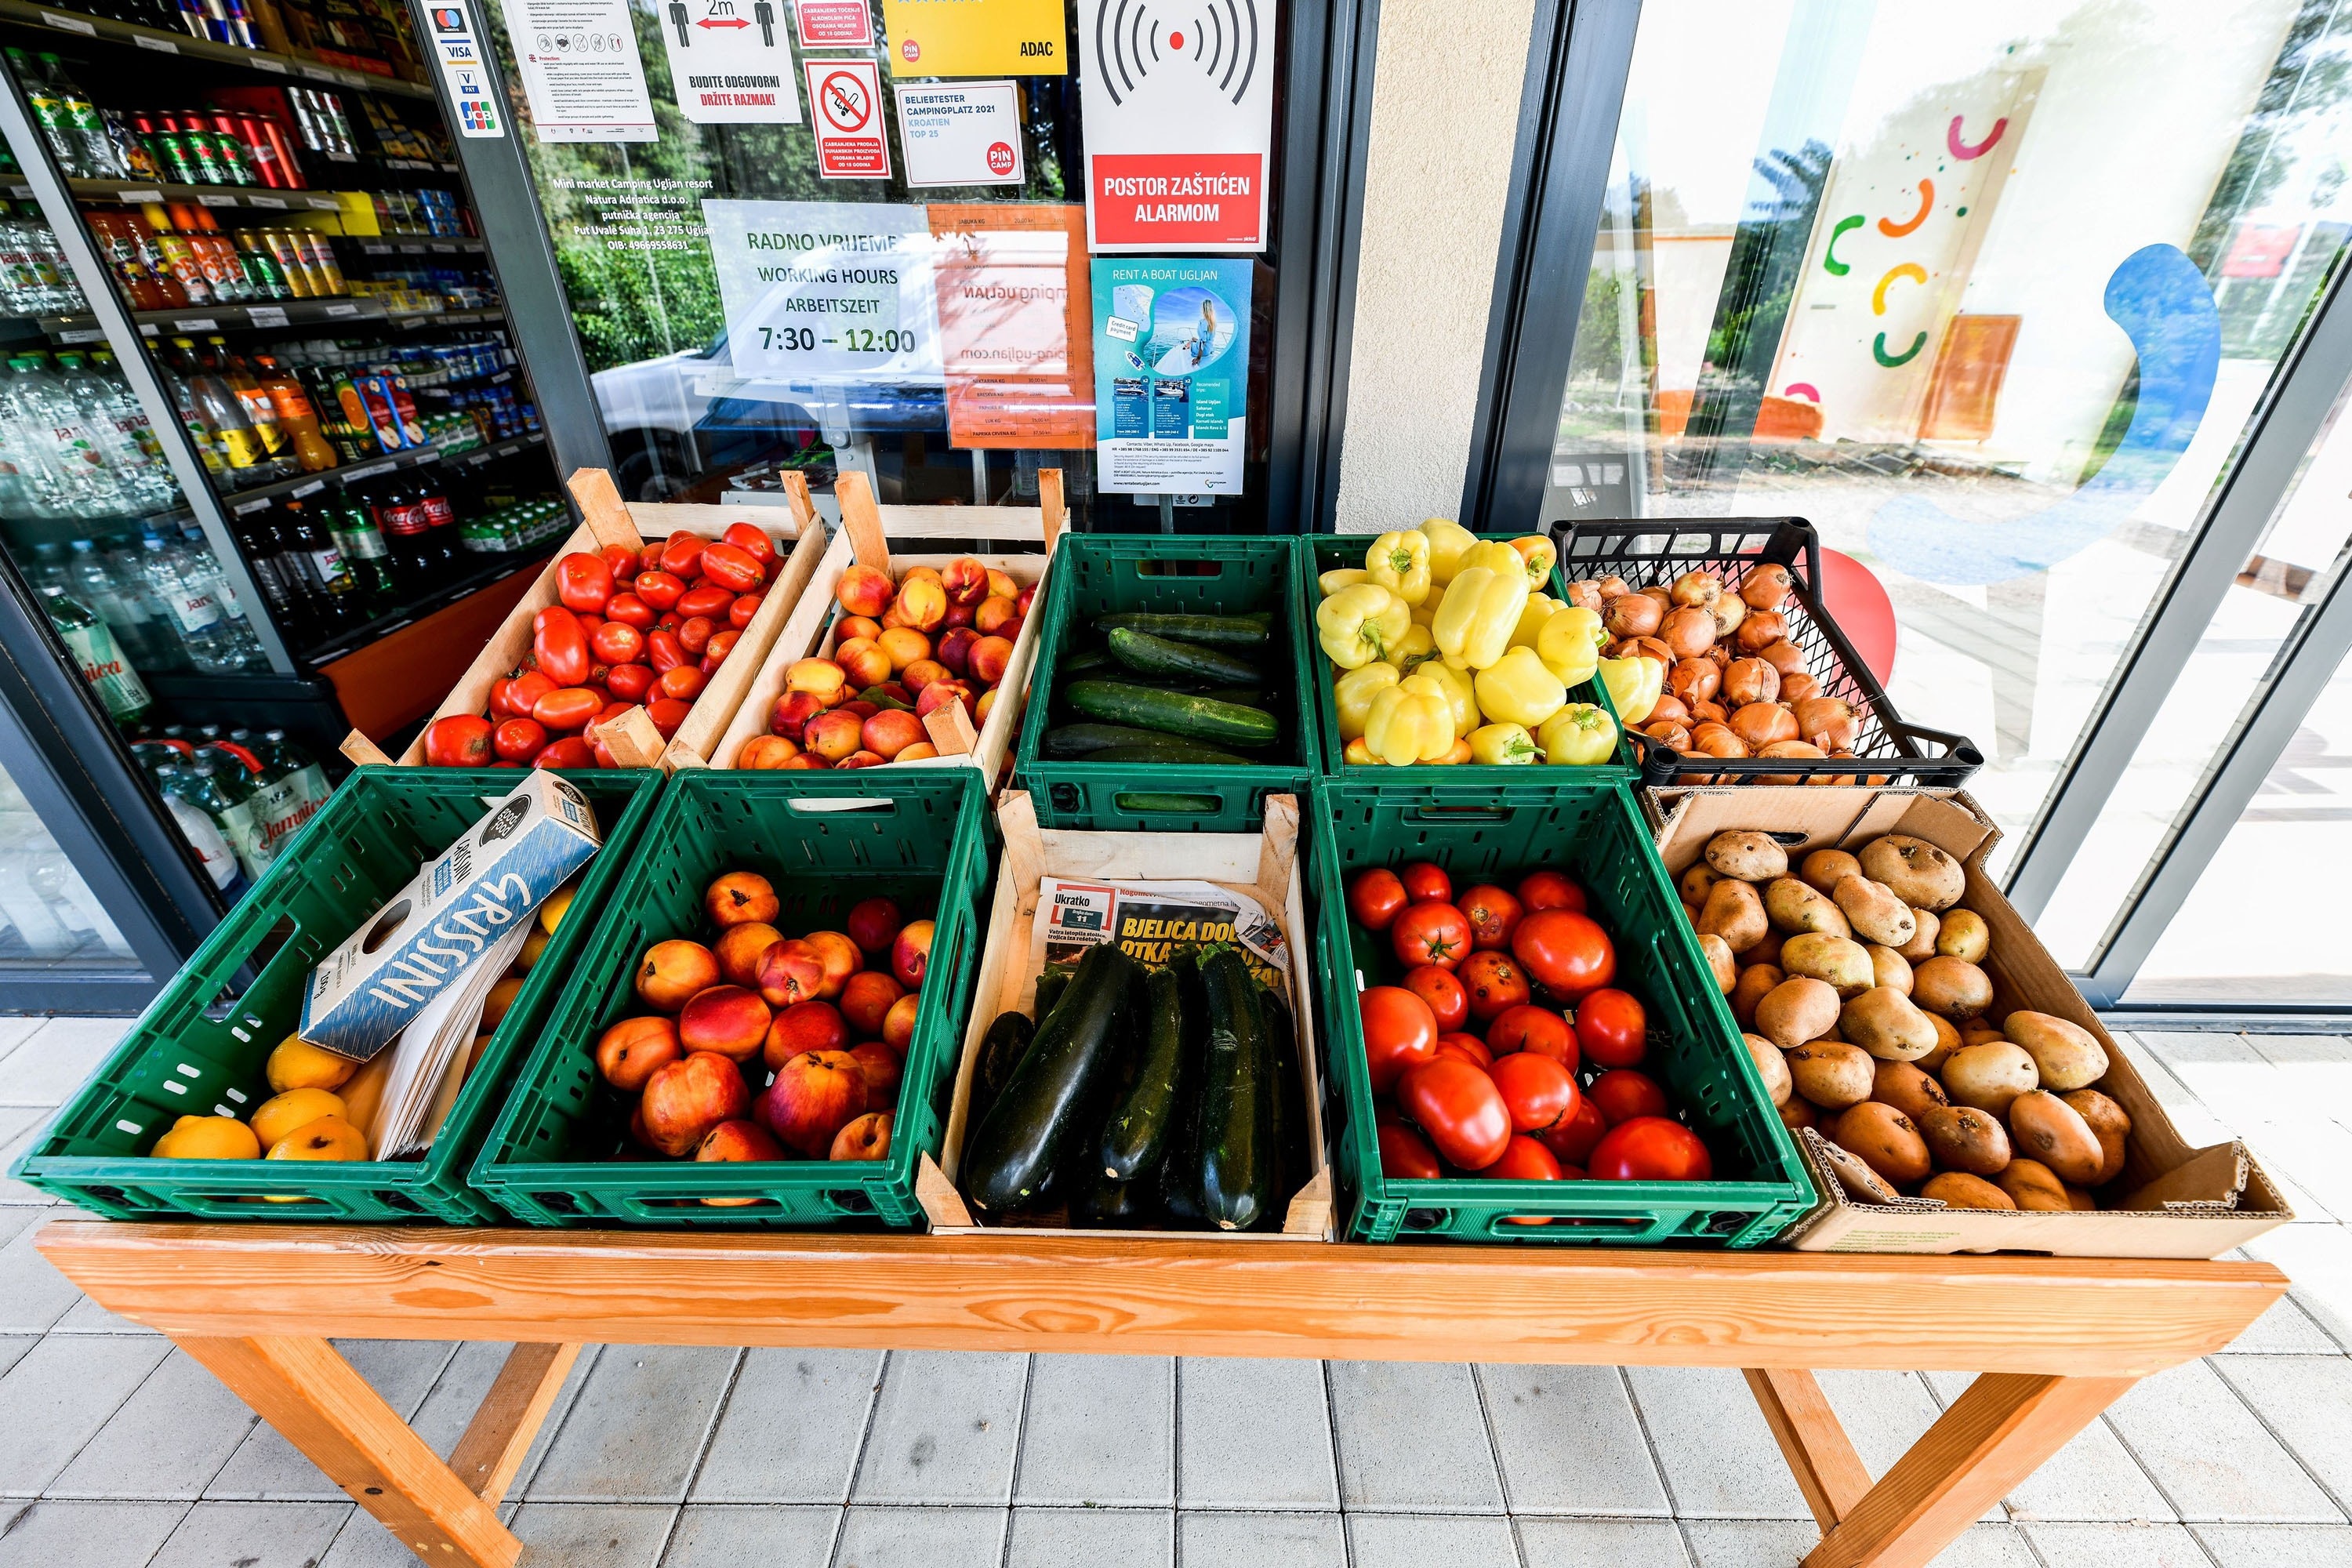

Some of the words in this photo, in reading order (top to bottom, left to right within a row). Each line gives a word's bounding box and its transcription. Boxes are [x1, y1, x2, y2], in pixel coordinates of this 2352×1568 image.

[708, 0, 735, 15] 2m
[445, 46, 472, 57] VISA
[1020, 42, 1053, 56] ADAC
[460, 73, 470, 84] V
[688, 75, 723, 88] BUDITE
[725, 75, 780, 88] ODGOVORNI
[700, 92, 732, 106] DRŽITE
[735, 94, 775, 106] RAZMAK!
[905, 95, 965, 103] BELIEBTESTER
[465, 110, 492, 121] JCB
[907, 106, 972, 115] CAMPINGPLATZ
[909, 118, 950, 127] KROATIEN
[553, 179, 575, 188] Mini
[577, 179, 609, 189] market
[612, 179, 652, 190] Camping
[653, 179, 683, 190] Ugljan
[684, 180, 713, 188] resort
[1104, 177, 1167, 196] POSTOR
[1171, 172, 1250, 195] ZAŠTIĆEN
[585, 195, 617, 204] Natura
[619, 195, 659, 204] Adriatica
[661, 195, 688, 204] d.o.o.
[601, 210, 641, 221] putnička
[642, 210, 680, 221] agencija
[1134, 204, 1219, 222] ALARMOM
[574, 226, 590, 234] Put
[591, 226, 618, 234] Uvale
[619, 226, 641, 234] Suha
[643, 226, 652, 236] 1,
[654, 226, 666, 234] 23
[667, 226, 684, 234] 275
[685, 226, 715, 237] Ugljan
[608, 241, 627, 249] OIB:
[629, 241, 688, 250] 49669558631
[746, 233, 815, 250] RADNO
[818, 234, 898, 252] VRIJEME
[758, 267, 837, 283] WORKING
[842, 269, 898, 284] HOURS
[1112, 270, 1139, 280] RENT
[1142, 270, 1149, 280] A
[1151, 270, 1177, 280] BOAT
[1179, 270, 1218, 281] UGLJAN
[786, 298, 880, 314] ARBEITSZEIT
[1110, 327, 1131, 336] payment
[1111, 321, 1125, 329] Credit
[758, 327, 815, 351] 7:30
[845, 328, 916, 353] 12:00
[497, 808, 521, 825] good
[490, 818, 514, 837] food
[453, 838, 472, 884] GRISSINI
[1054, 894, 1090, 907] Ukratko
[1121, 917, 1196, 941] BJELICA
[369, 873, 531, 1009] GRISSINI
[1120, 940, 1184, 964] OTKA
[314, 971, 331, 1000] 200g
